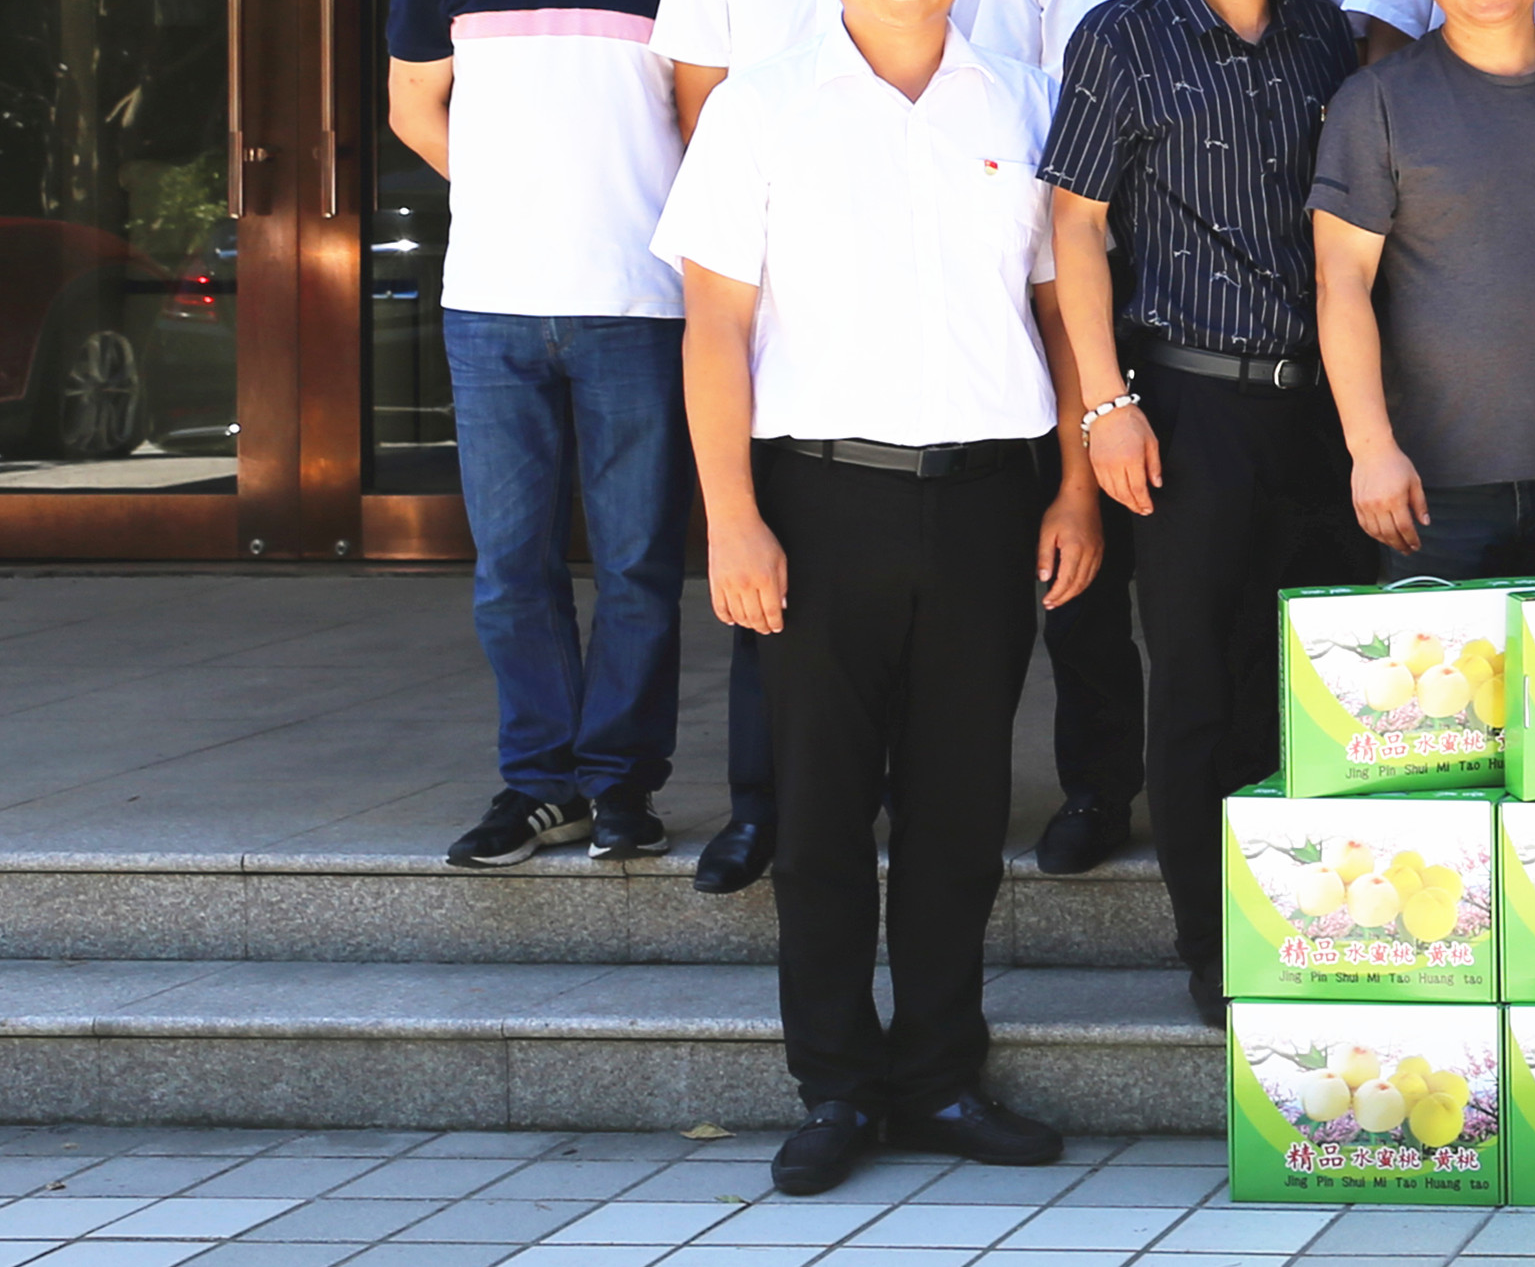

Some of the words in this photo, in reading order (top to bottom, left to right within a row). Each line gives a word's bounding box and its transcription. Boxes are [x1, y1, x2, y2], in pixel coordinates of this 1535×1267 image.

[1349, 733, 1407, 762] 精品
[1416, 731, 1485, 753] 水蜜桃
[1346, 768, 1369, 779] Jing
[1379, 766, 1396, 776] Pin
[1405, 764, 1428, 774] Shui
[1437, 763, 1449, 773] Mi
[1459, 761, 1481, 771] Tao
[1281, 939, 1337, 966] 精品
[1346, 943, 1414, 963] 水蜜桃
[1427, 943, 1472, 964] 黄桃
[1279, 971, 1302, 983] Jing
[1311, 973, 1327, 982] Pin
[1336, 973, 1359, 982] Shui
[1367, 973, 1380, 982] Mi
[1389, 974, 1410, 982] Tao
[1419, 974, 1454, 985] Huang
[1464, 974, 1483, 984] tao
[1287, 1144, 1343, 1171] 精品
[1352, 1148, 1420, 1168] 水蜜桃
[1433, 1149, 1478, 1169] 黄桃
[1284, 1177, 1308, 1188] Jing
[1317, 1177, 1333, 1187] Pin
[1342, 1178, 1365, 1187] Shui
[1374, 1178, 1386, 1187] Mi
[1396, 1178, 1417, 1188] Tao
[1425, 1179, 1461, 1190] Huang
[1470, 1179, 1489, 1189] tao
